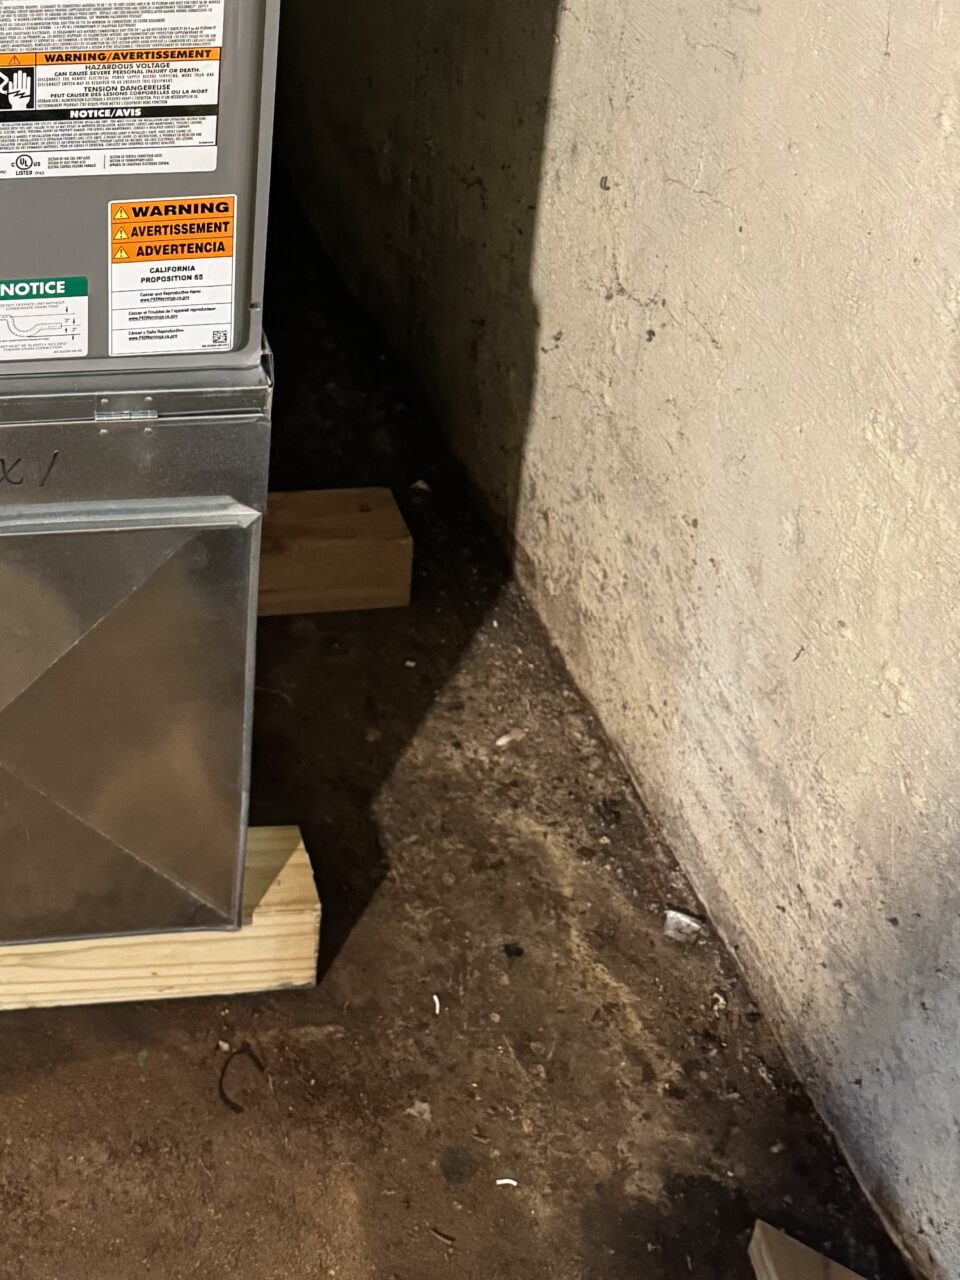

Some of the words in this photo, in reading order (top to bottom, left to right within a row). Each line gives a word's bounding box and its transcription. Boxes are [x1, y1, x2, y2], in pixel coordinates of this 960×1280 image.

[44, 49, 211, 63] WARNING/AVERTISSEMENT
[70, 108, 141, 118] NOTICE/AVIS
[132, 202, 230, 217] WARNING
[131, 221, 230, 237] AVERTISSEMENT
[136, 241, 225, 257] ADVERTENCIA
[150, 265, 196, 274] CALIFORNIA
[141, 275, 192, 284] PROPOSITION
[0, 281, 66, 296] NOTICE
